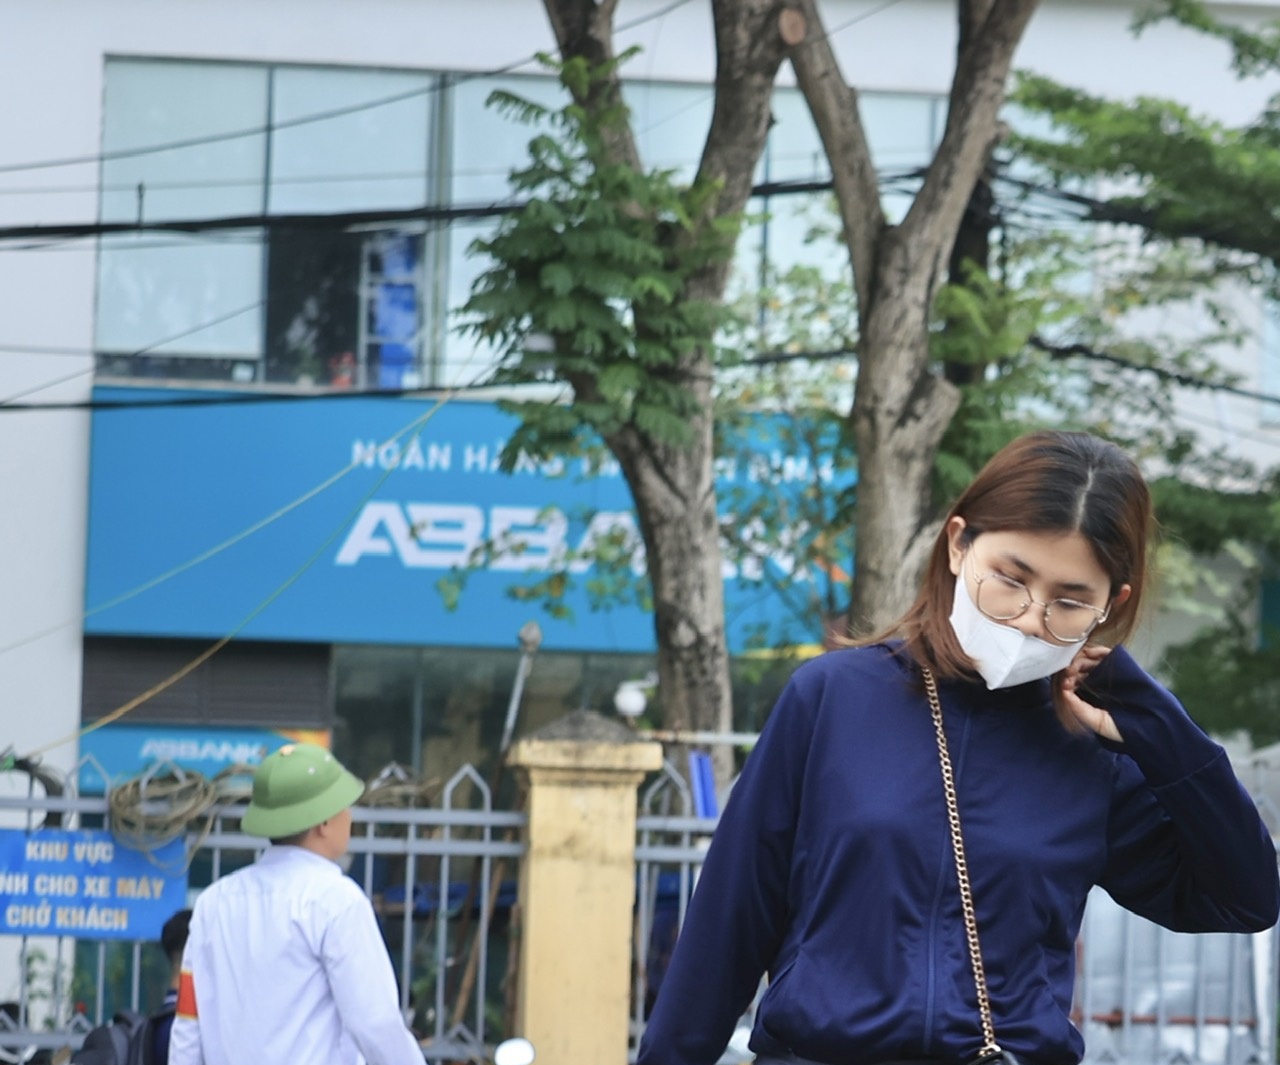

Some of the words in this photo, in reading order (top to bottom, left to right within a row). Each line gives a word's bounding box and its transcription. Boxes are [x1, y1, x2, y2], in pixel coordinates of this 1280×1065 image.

[352, 437, 451, 472] NGÂN
[26, 841, 68, 862] KHU
[0, 872, 29, 895] NH
[34, 873, 78, 897] CHO
[84, 876, 110, 898] XE
[56, 903, 128, 931] KHÁCH
